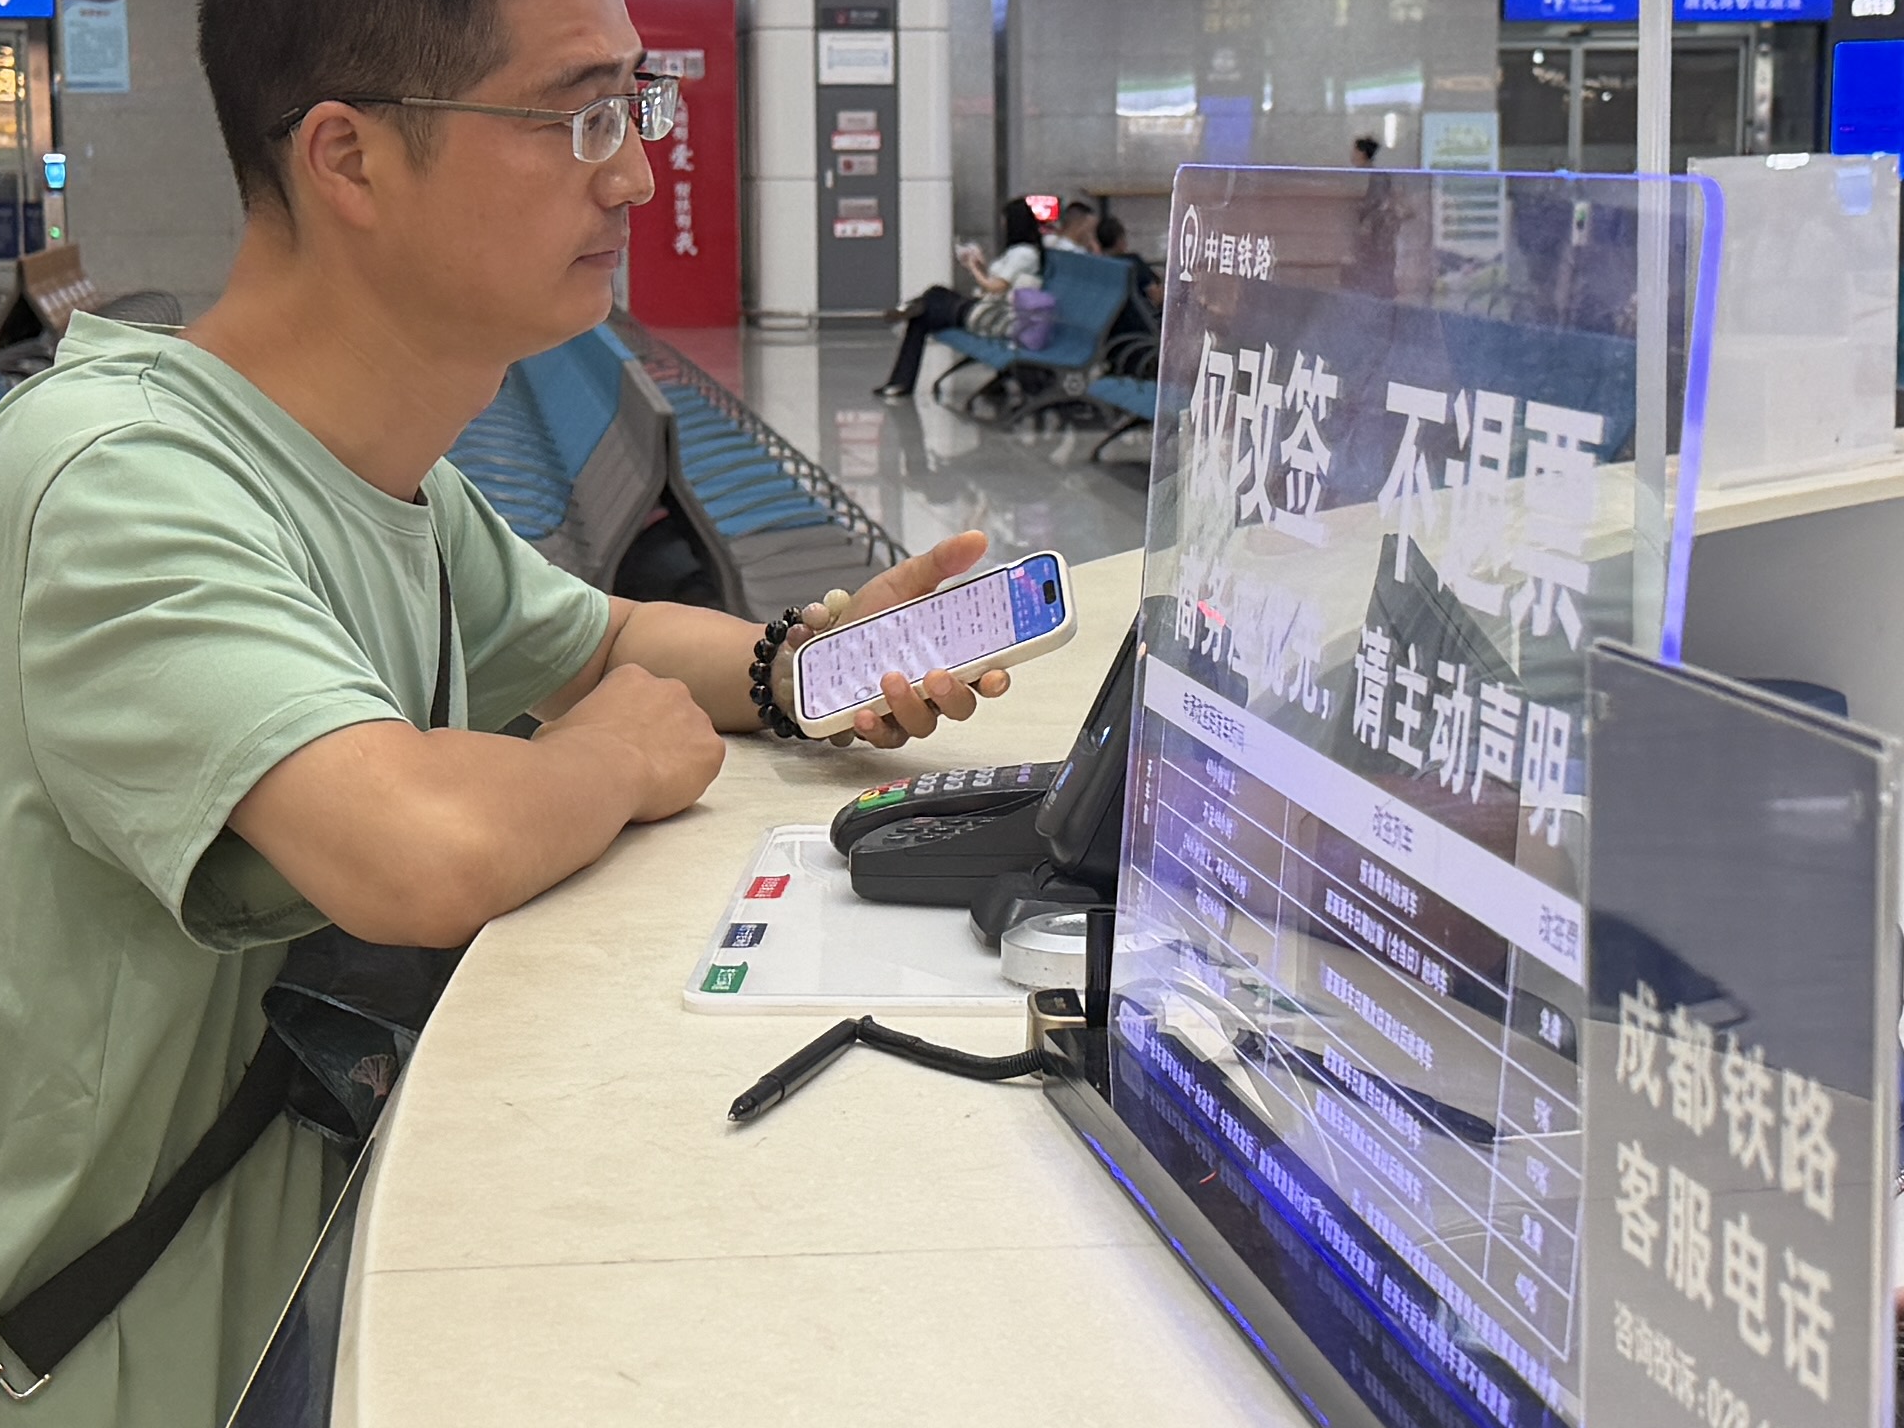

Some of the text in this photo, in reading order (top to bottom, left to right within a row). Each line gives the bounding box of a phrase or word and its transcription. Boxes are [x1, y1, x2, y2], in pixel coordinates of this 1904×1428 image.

[1204, 231, 1274, 283] 中国铁路
[1190, 330, 1605, 651] 仅改签 不退票
[1352, 625, 1573, 847] 请主动声明
[1615, 979, 1837, 1221] 成都铁路
[1614, 1140, 1835, 1403] 客服电话
